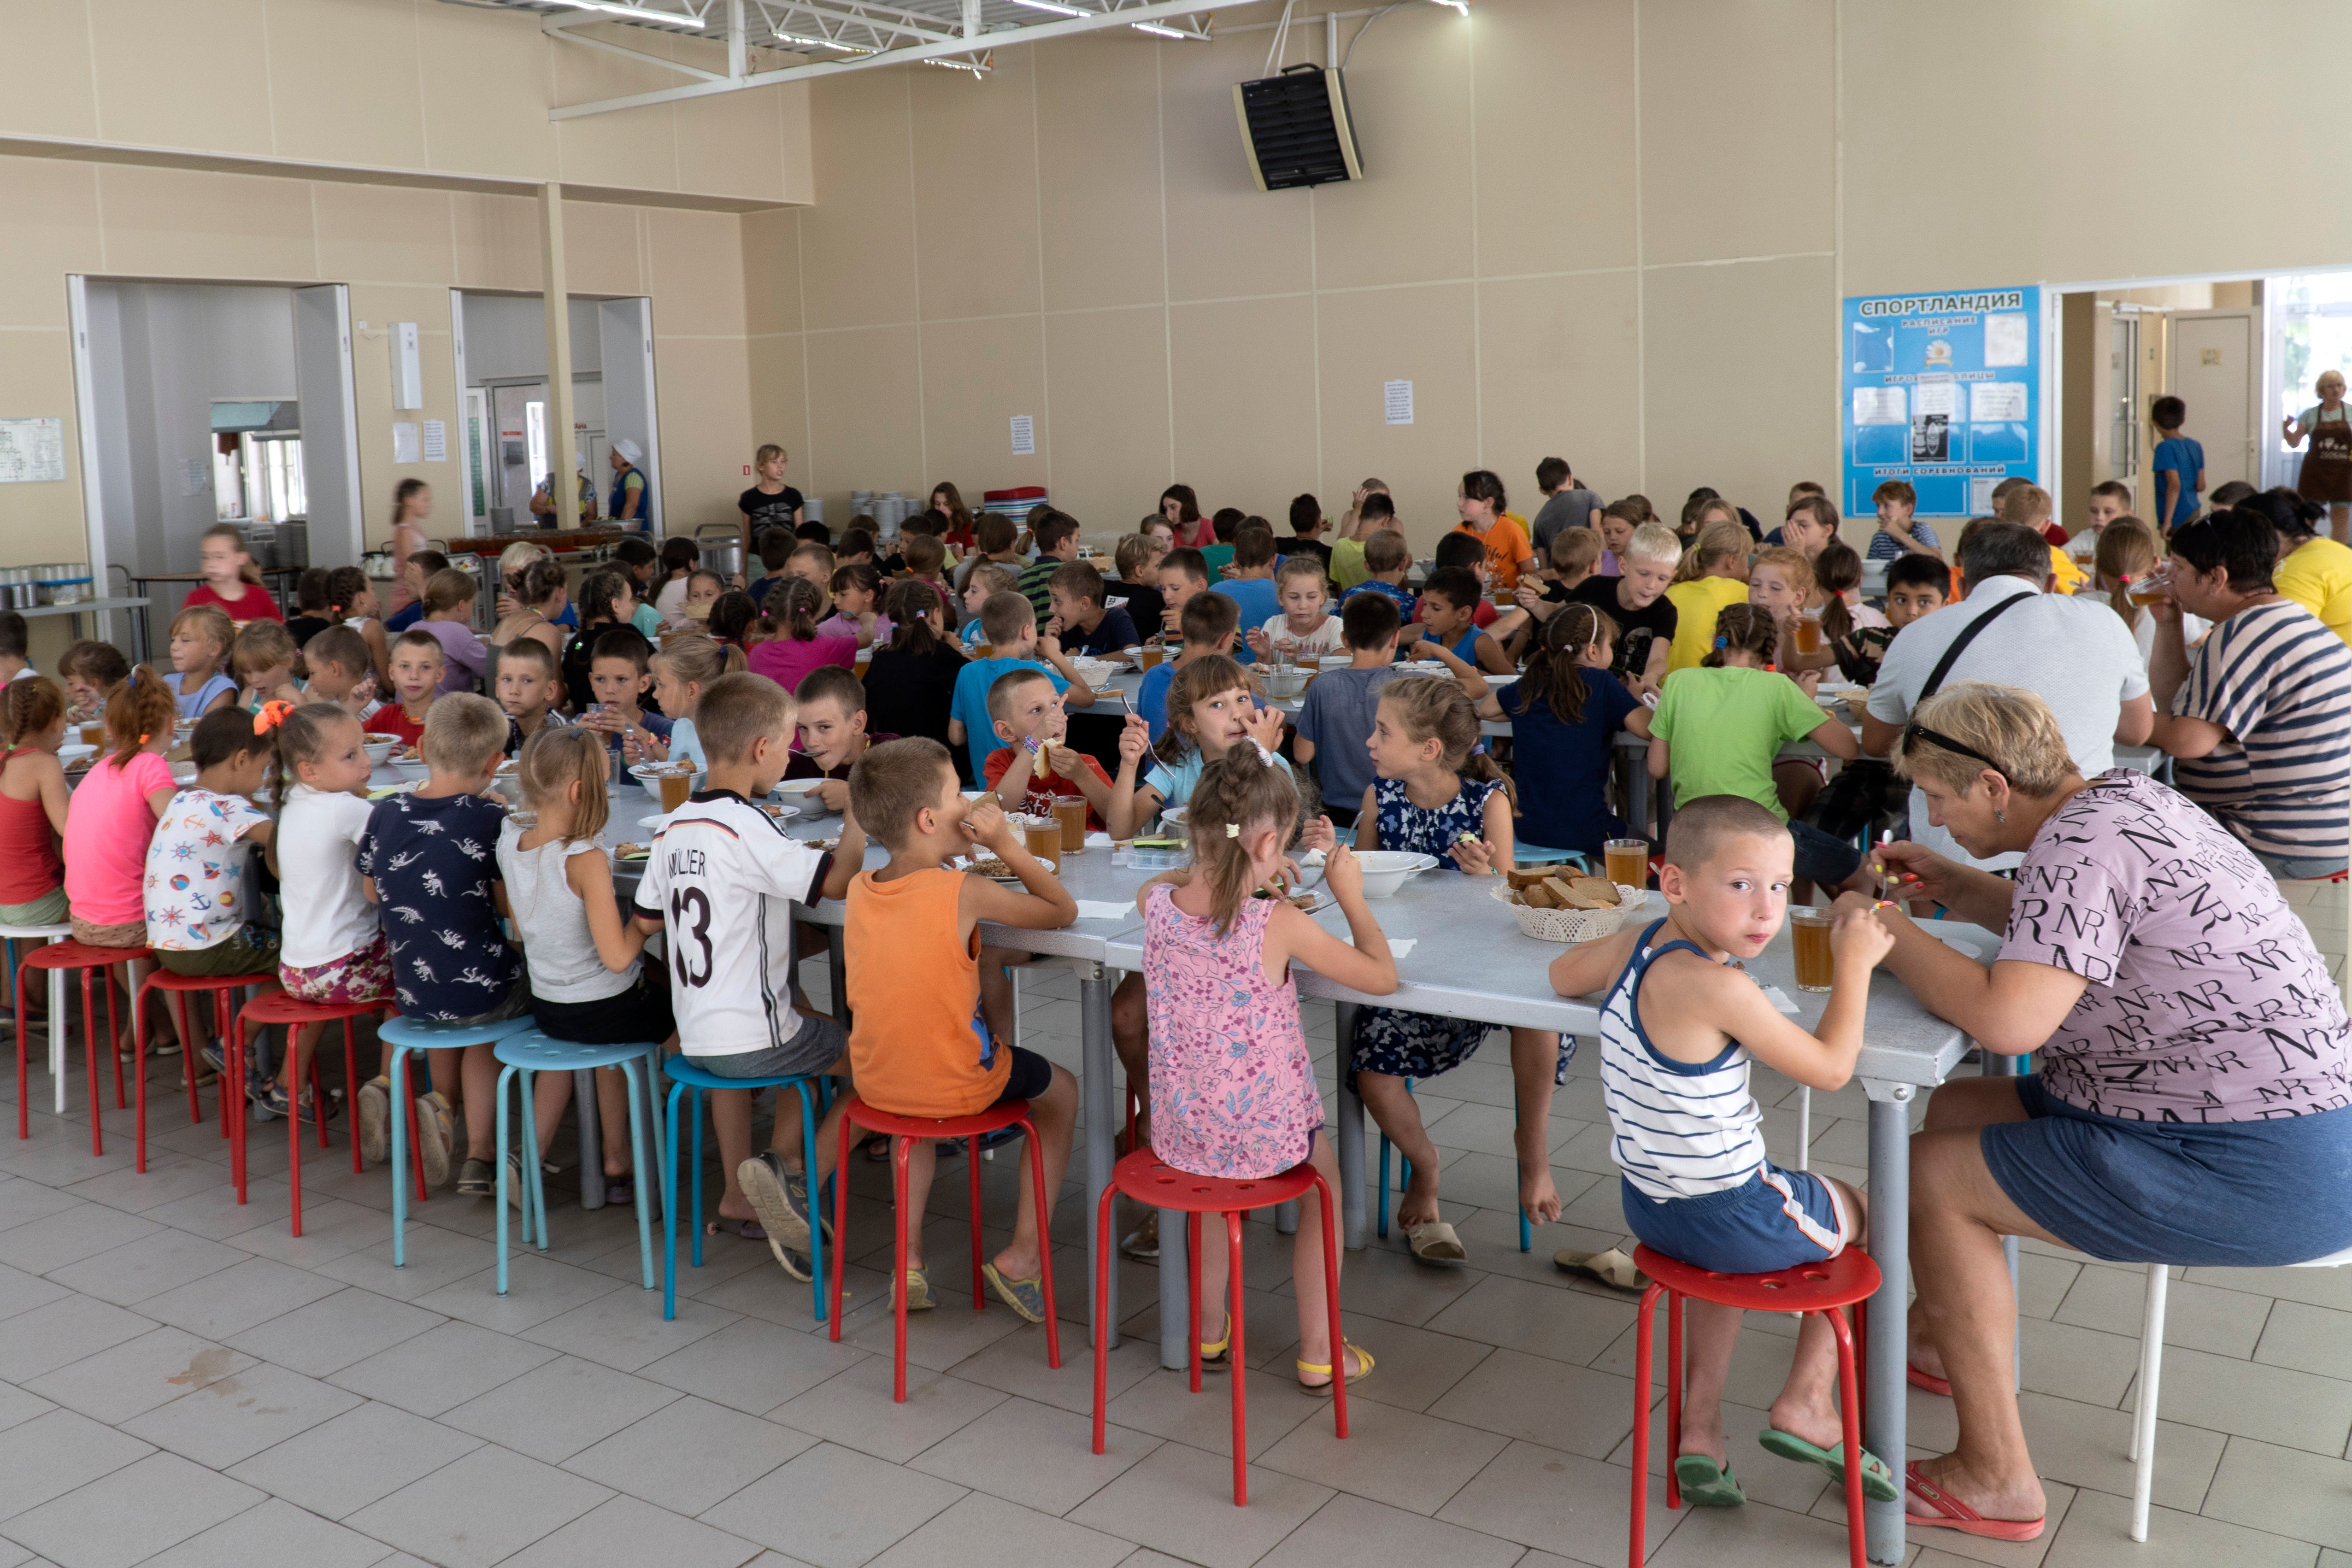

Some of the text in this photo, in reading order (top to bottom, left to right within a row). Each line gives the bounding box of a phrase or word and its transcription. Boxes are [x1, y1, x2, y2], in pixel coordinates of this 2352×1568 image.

[1861, 293, 2020, 316] СПОРТЛАНДИЯ
[1902, 316, 1977, 327] РАСПИСАНИЕ
[1929, 327, 1948, 335] ИГР
[1954, 371, 1994, 380] БЛИЦЫ
[1913, 464, 2005, 475] СОРЕВНОВАНИЙ
[2117, 814, 2191, 867] NR
[2028, 864, 2079, 899] NR
[2143, 859, 2198, 900] NR
[2187, 852, 2218, 879] NR
[2176, 878, 2232, 938] NR
[2236, 903, 2270, 935] NR
[671, 886, 712, 989] 13
[2051, 902, 2105, 948] NR
[2166, 942, 2226, 970] NR
[2231, 939, 2297, 982] NR
[2172, 980, 2241, 1019] NR
[2102, 1015, 2160, 1049] NR
[2253, 1079, 2317, 1104] NR
